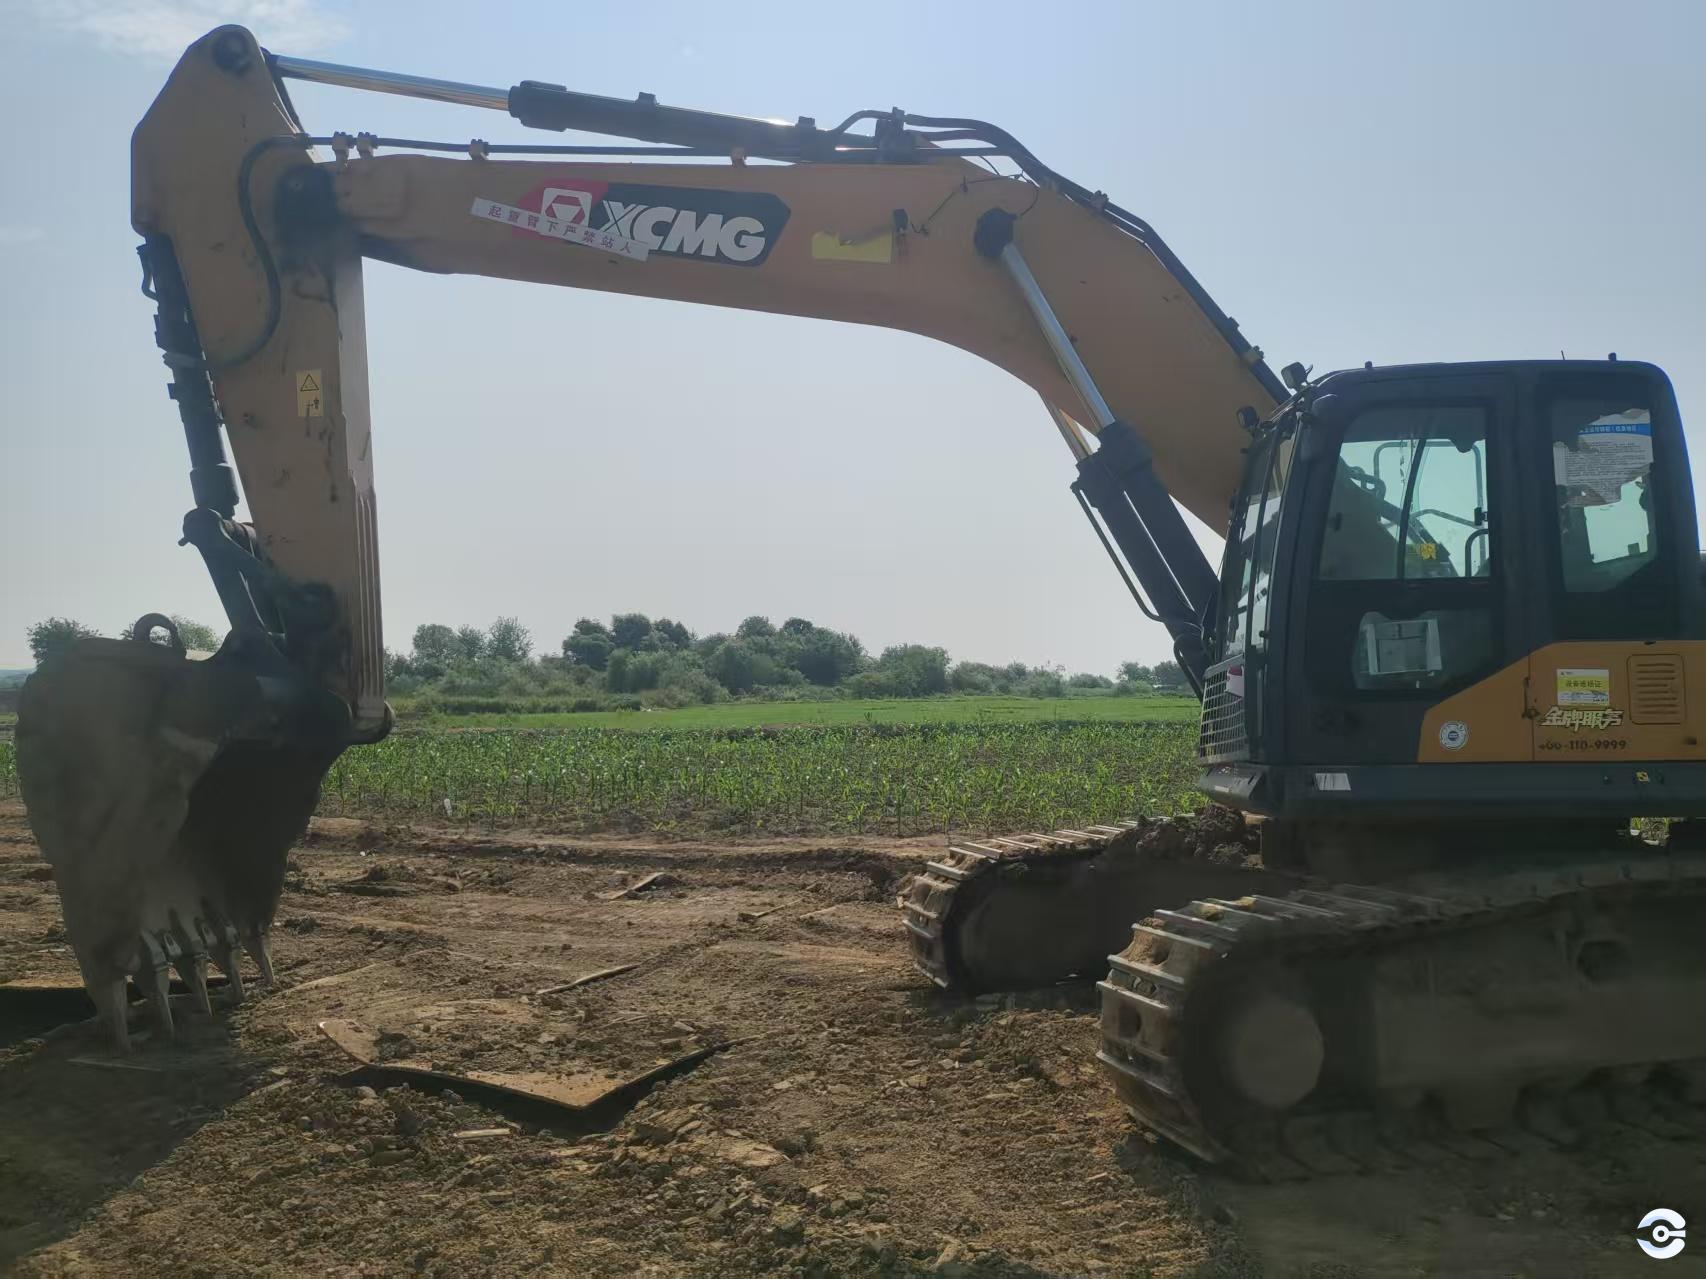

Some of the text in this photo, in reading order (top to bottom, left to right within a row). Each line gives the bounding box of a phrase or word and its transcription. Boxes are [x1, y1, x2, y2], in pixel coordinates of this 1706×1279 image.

[602, 200, 765, 262] XCMG
[1541, 706, 1624, 732] 金牌服务
